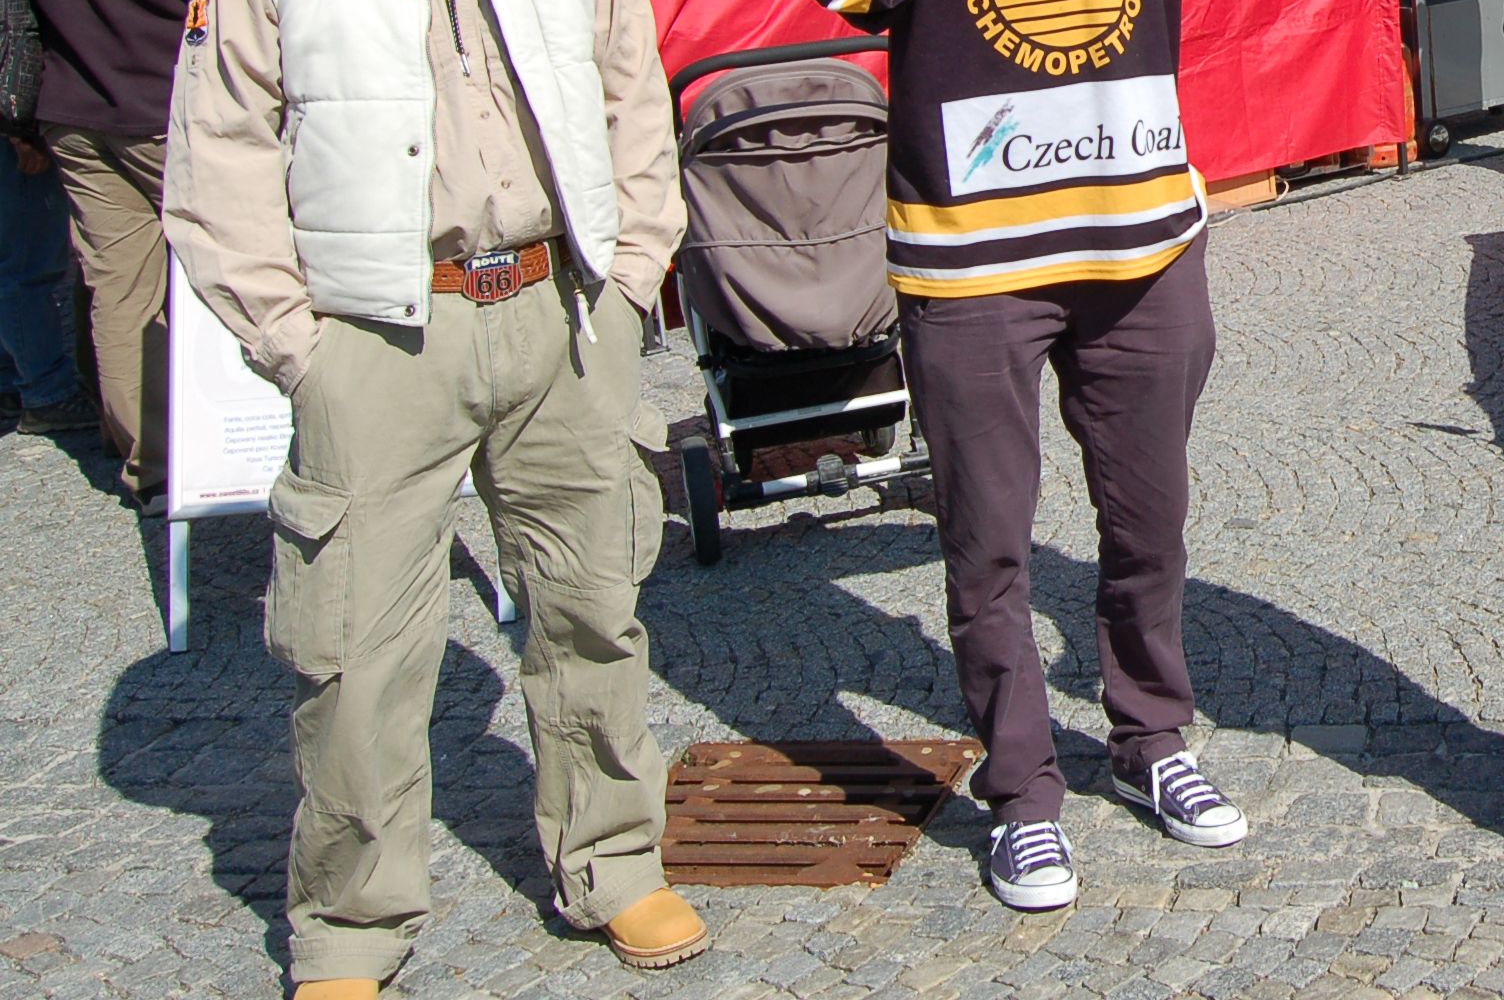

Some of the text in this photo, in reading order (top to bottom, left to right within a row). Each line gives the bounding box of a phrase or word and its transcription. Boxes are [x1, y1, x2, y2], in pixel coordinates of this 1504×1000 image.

[1002, 115, 1182, 172] Czech Coal
[471, 253, 515, 270] ROUTE
[477, 270, 512, 294] 66
